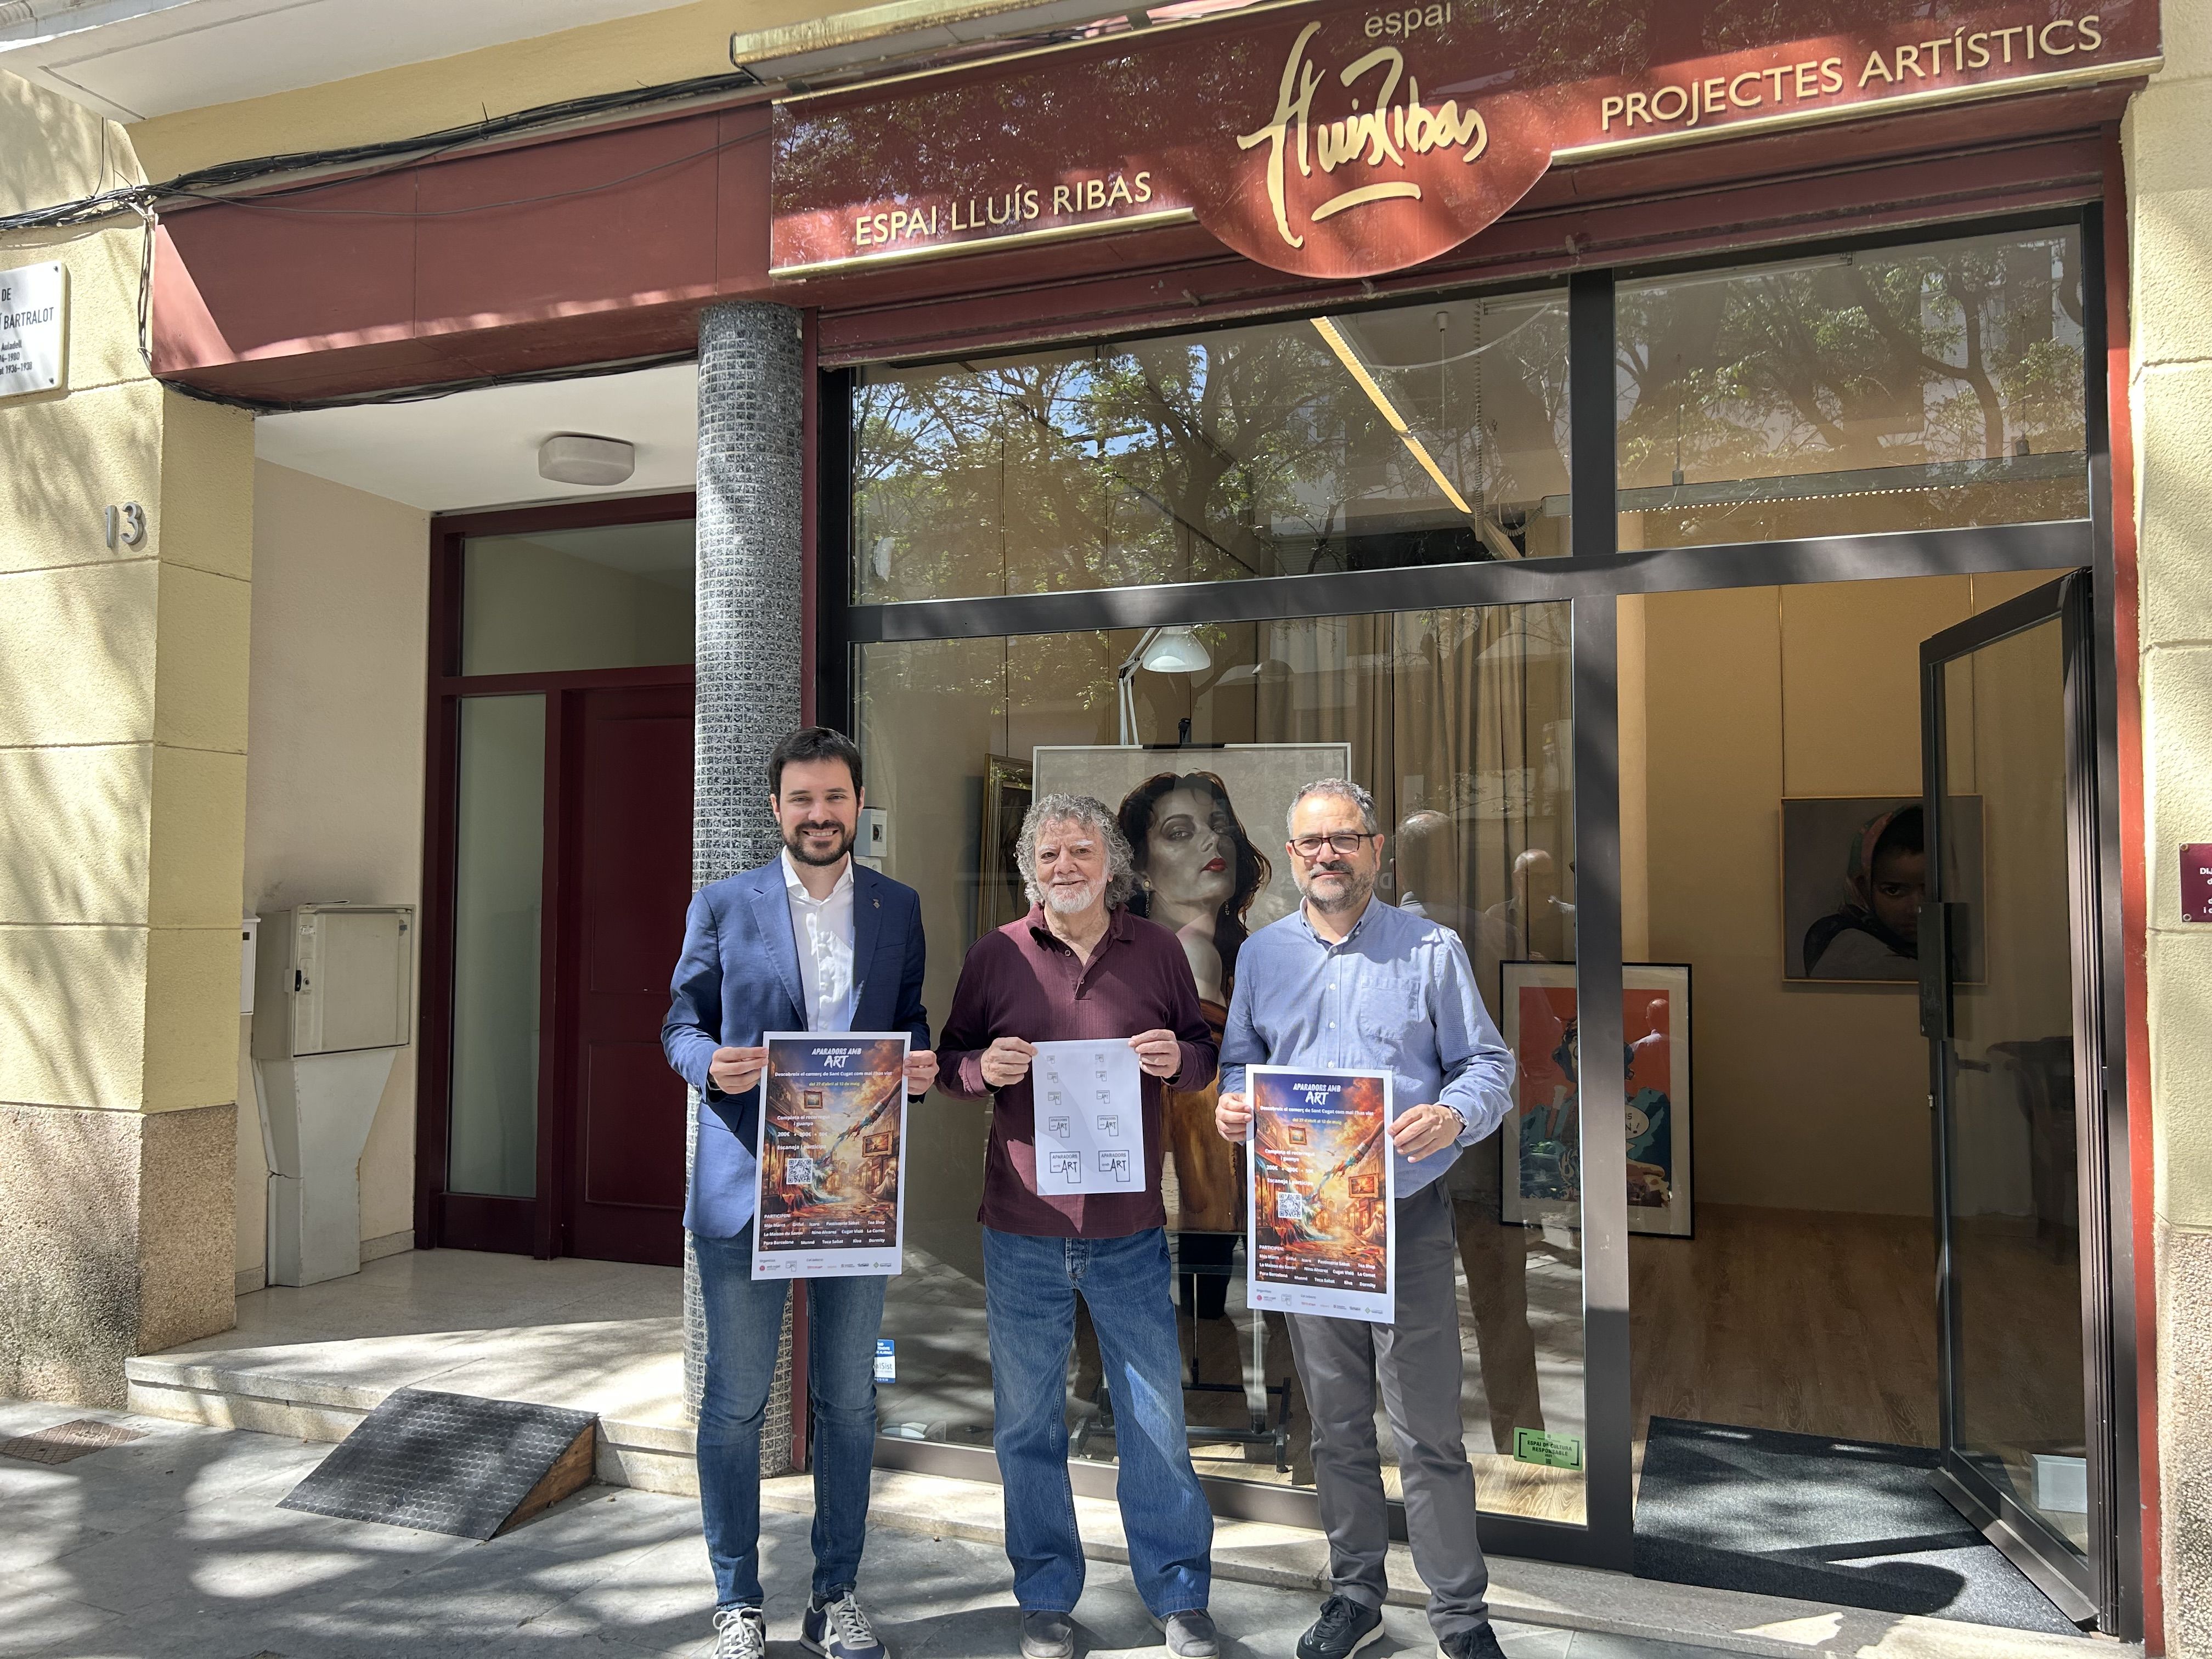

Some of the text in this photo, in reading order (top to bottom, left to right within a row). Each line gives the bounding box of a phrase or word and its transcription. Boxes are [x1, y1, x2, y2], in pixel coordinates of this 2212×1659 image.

[1364, 1, 1452, 38] espai
[1601, 14, 2102, 132] PROJECTES ARTÍSTICS
[855, 171, 1152, 245] ESPAI LLUÍS RIBAS
[2, 287, 12, 302] DE
[4, 307, 54, 330] BARTRALOT
[1, 338, 22, 351] Auladell
[105, 501, 143, 549] 13
[823, 1055, 849, 1069] ART
[1293, 1083, 1327, 1092] APARADORS
[1305, 1091, 1329, 1105] ART
[1057, 1122, 1068, 1131] ART
[1105, 1121, 1116, 1129] ART
[1062, 1160, 1077, 1173] ART
[1111, 1159, 1126, 1171] ART
[1532, 1446, 1568, 1456] RESPONSABLE
